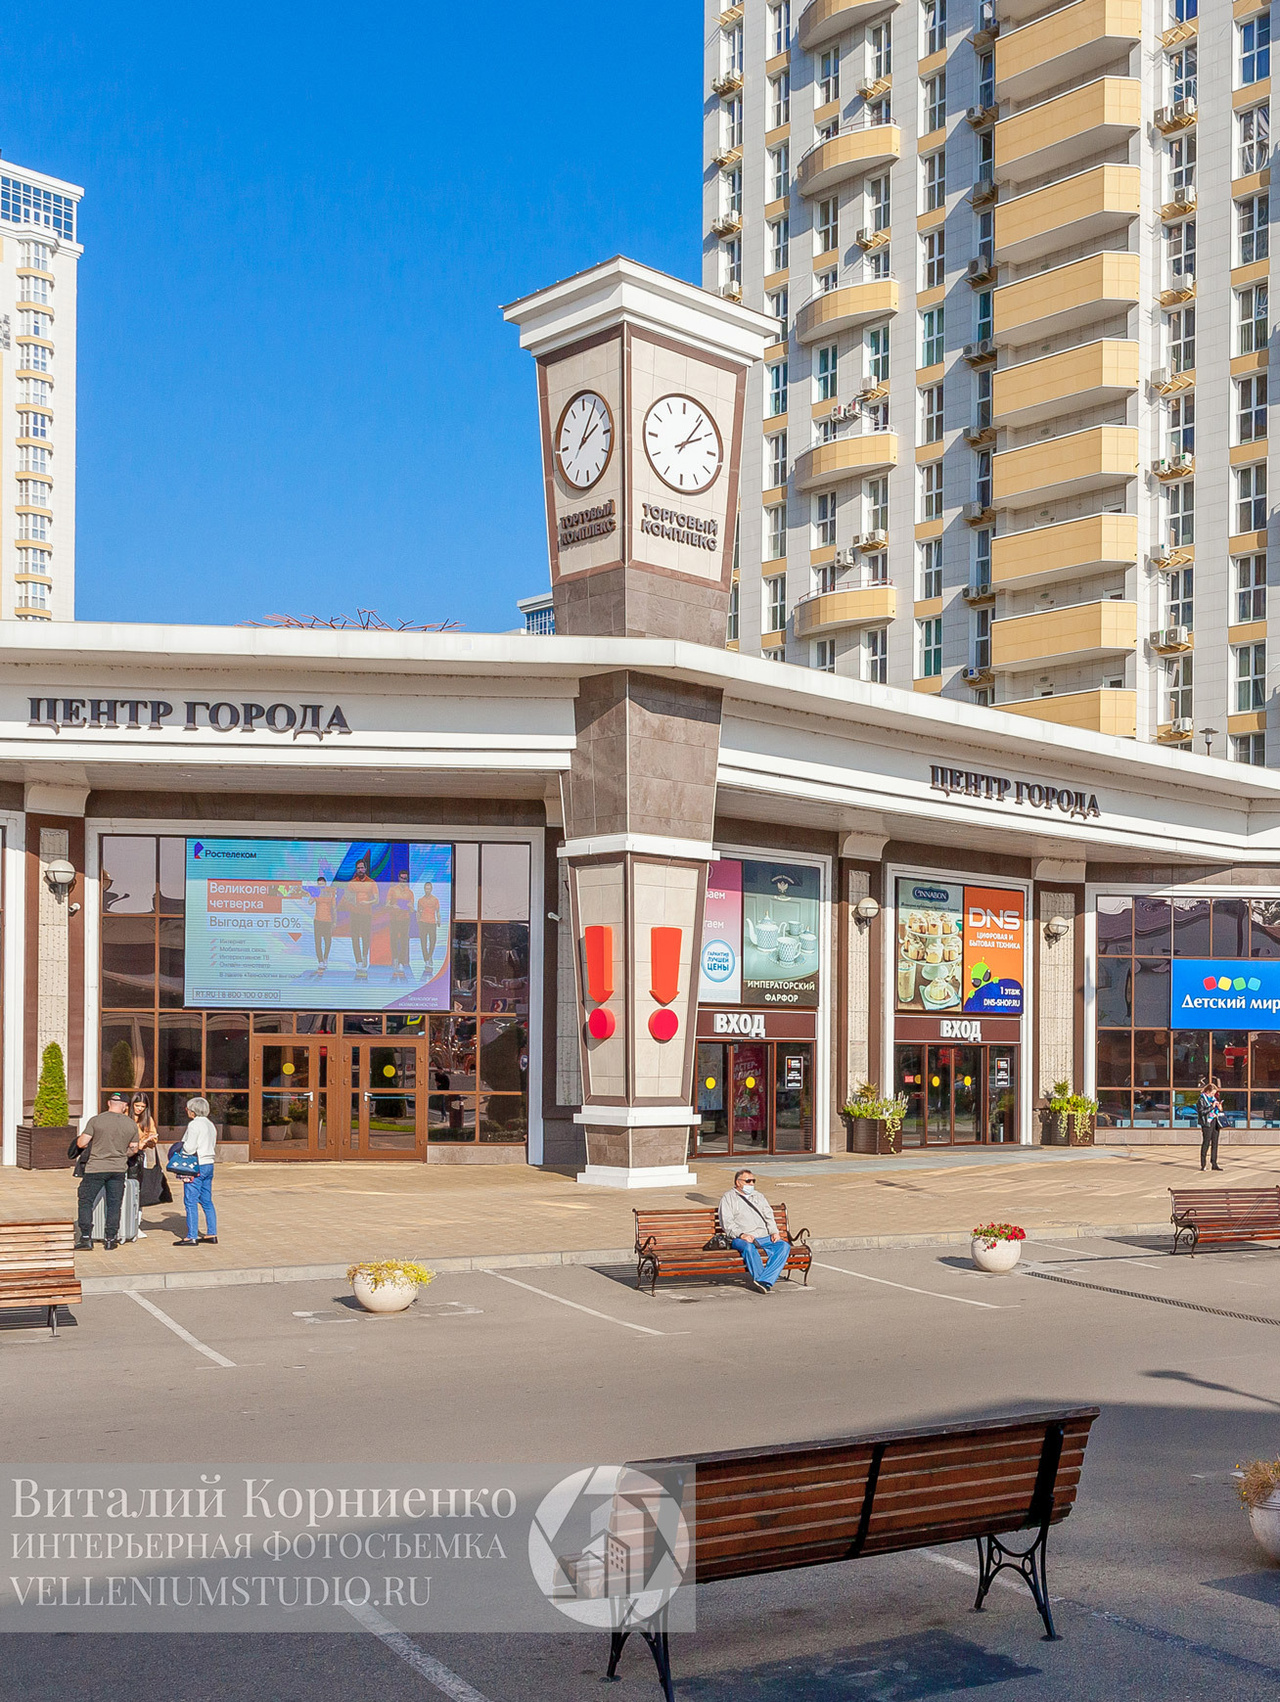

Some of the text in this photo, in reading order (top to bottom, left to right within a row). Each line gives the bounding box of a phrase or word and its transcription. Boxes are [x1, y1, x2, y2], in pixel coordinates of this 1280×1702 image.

[559, 499, 616, 529] ТОРГОВЫЙ
[642, 503, 719, 537] ТОРГОВЫЙ
[559, 519, 616, 546] КОМПЛЕКС
[641, 519, 718, 552] КОМПЛЕКС
[27, 697, 353, 741] ЦЕНТР ГОРОДА
[929, 764, 1101, 820] ЦЕНТР ГОРОДА
[205, 849, 257, 859] Ростелеком
[209, 882, 269, 894] Великоле
[914, 889, 948, 900] CINNABON
[209, 899, 264, 911] четверка
[209, 916, 301, 929] Выгода от 50%
[968, 907, 1020, 930] DNS
[976, 932, 1009, 941] ЦИФРОВАЯ
[969, 939, 1021, 949] БЫТОВАЯ ТЕХНИКА
[707, 963, 730, 971] ЦЕНЫ
[747, 980, 816, 991] ИМПЕРАТОРСКИЙ
[1000, 986, 1021, 996] 1 этаж
[765, 993, 799, 1003] ФАРФОР
[984, 998, 1021, 1008] DNS-SHOP.RU
[1181, 994, 1246, 1009] Детский
[714, 1013, 766, 1039] ВХОД
[940, 1020, 982, 1043] ВХОД
